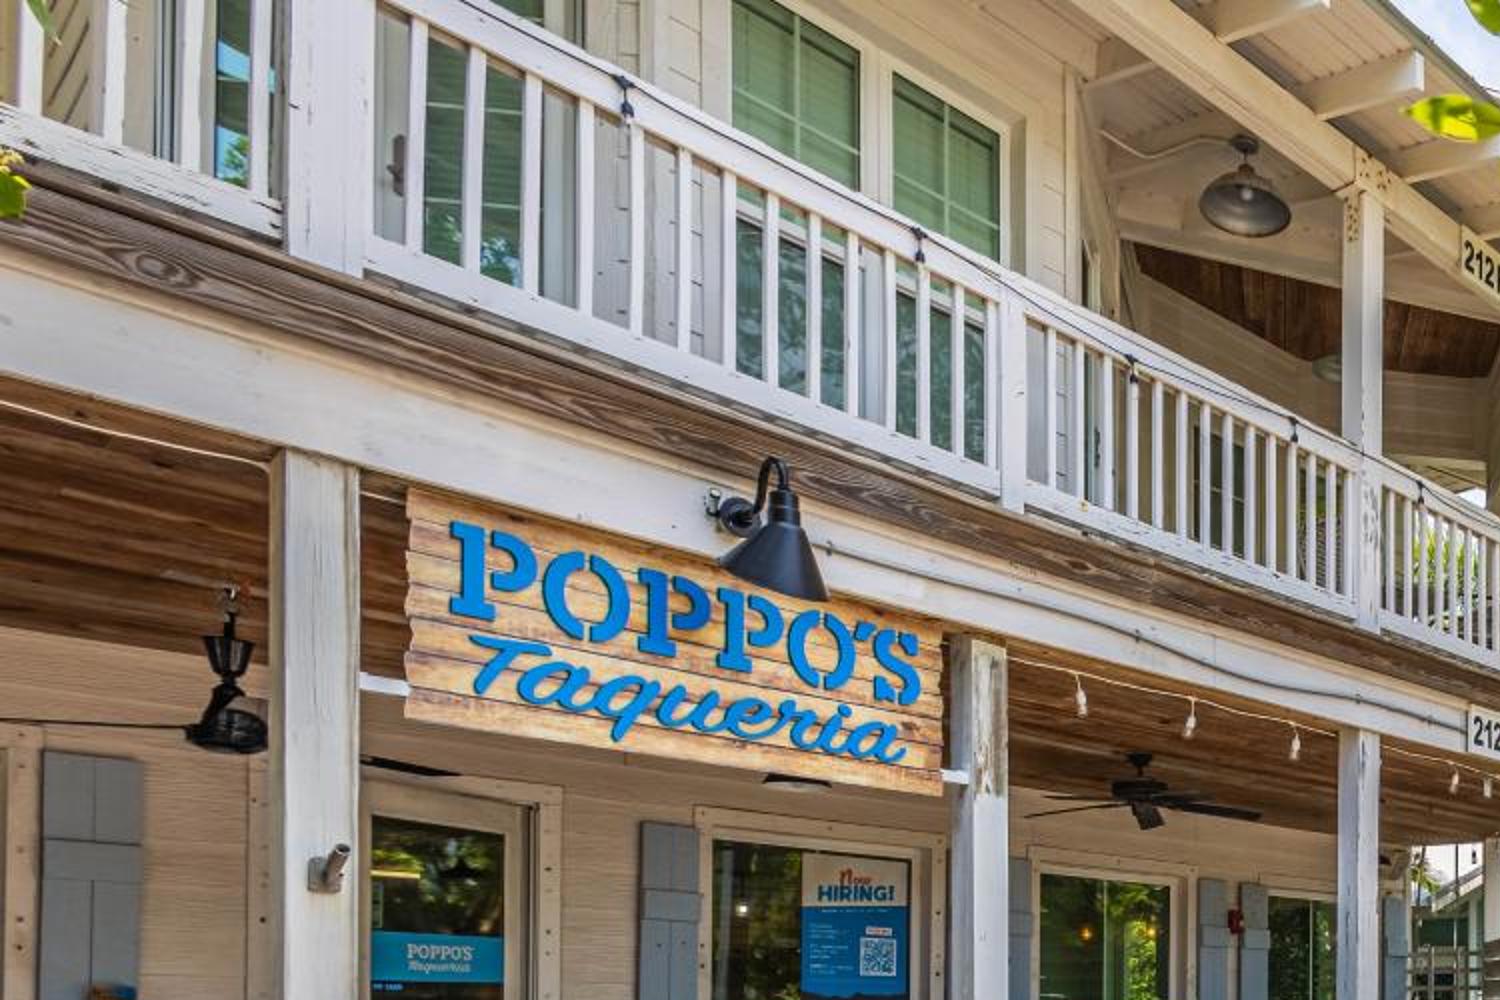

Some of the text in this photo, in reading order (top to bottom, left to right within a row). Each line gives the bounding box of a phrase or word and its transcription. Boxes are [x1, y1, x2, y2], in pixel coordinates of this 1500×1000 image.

[448, 520, 922, 706] POPPO'S
[469, 634, 907, 765] Taqueria
[817, 885, 895, 901] HIRING!
[406, 943, 475, 961] POPPO'S
